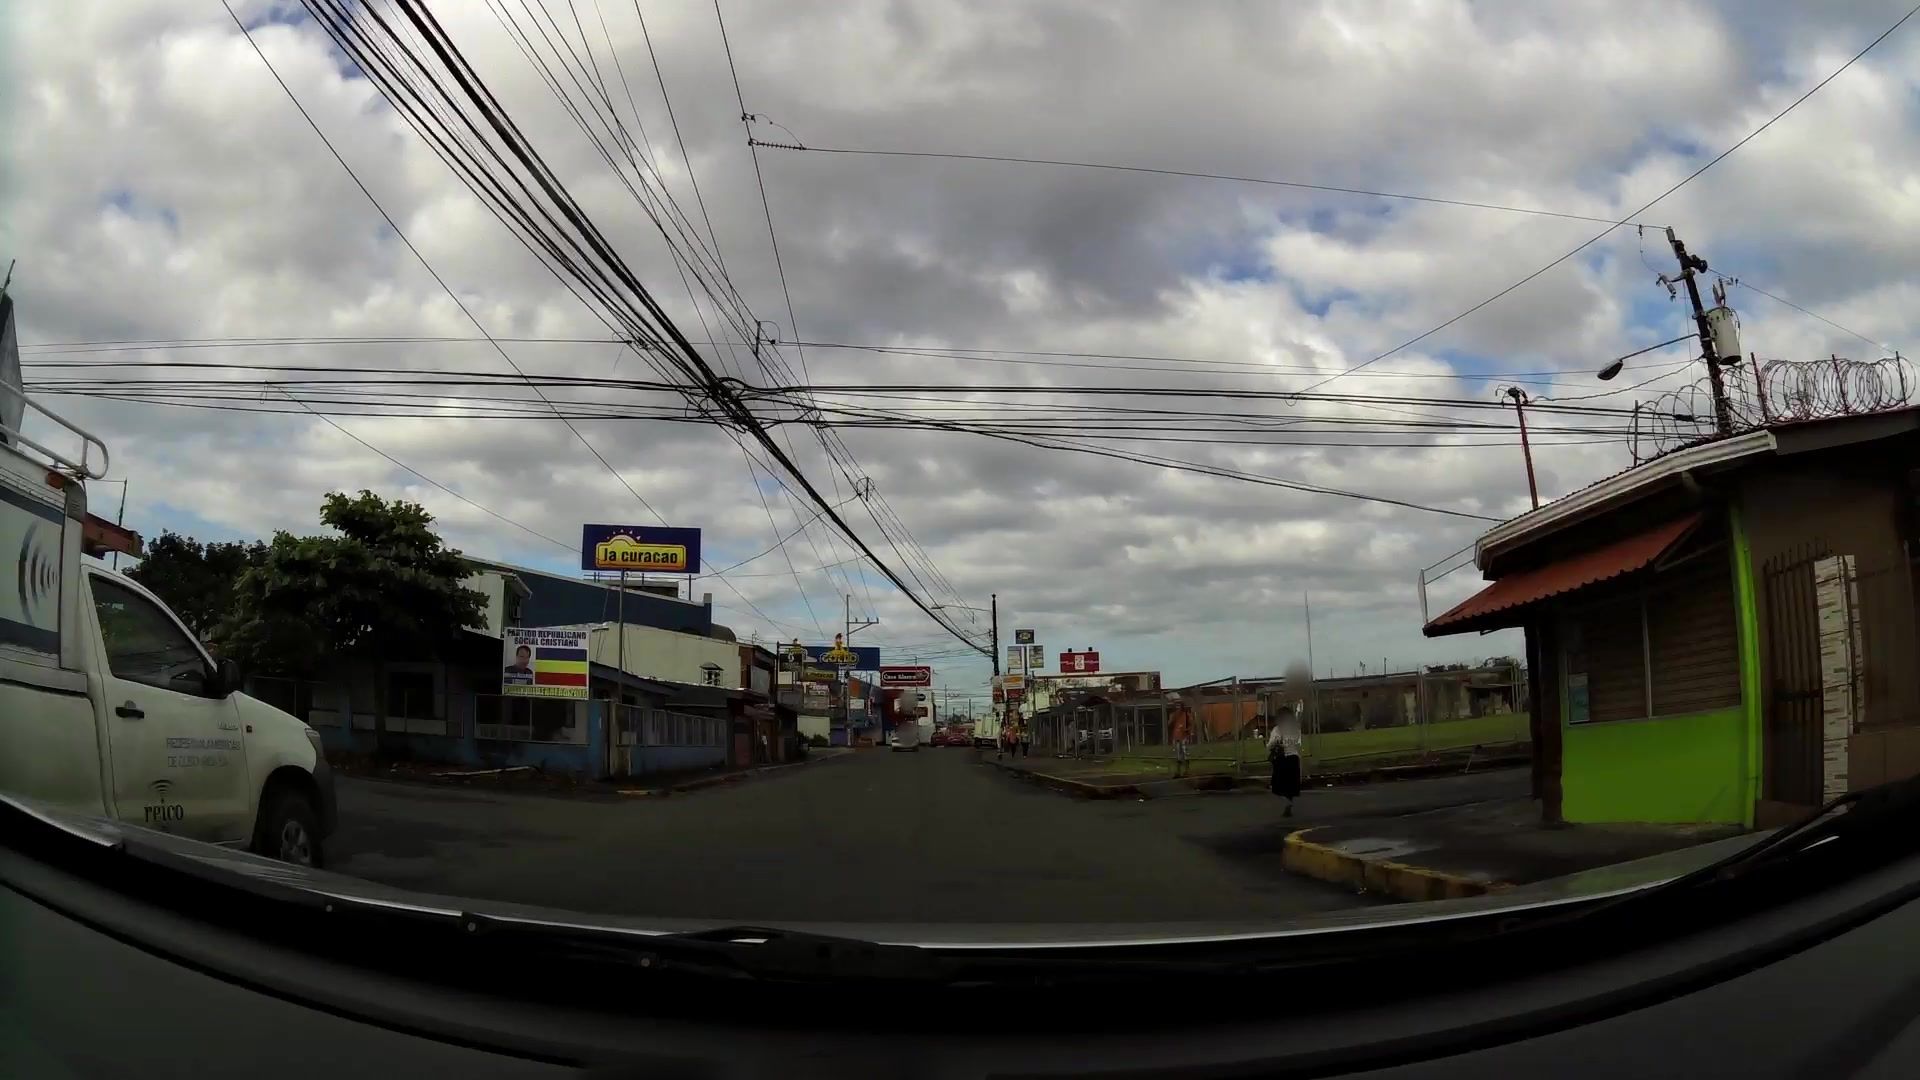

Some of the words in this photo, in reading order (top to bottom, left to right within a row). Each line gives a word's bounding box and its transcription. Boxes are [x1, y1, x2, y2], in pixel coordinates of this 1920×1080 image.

[604, 548, 617, 562] la
[621, 551, 678, 564] curacao
[507, 629, 537, 637] PARTIDO
[538, 630, 586, 640] REPUBLICANO
[514, 637, 539, 646] SOCIAL
[540, 638, 579, 647] CRISTIANO
[144, 798, 184, 823] reico
